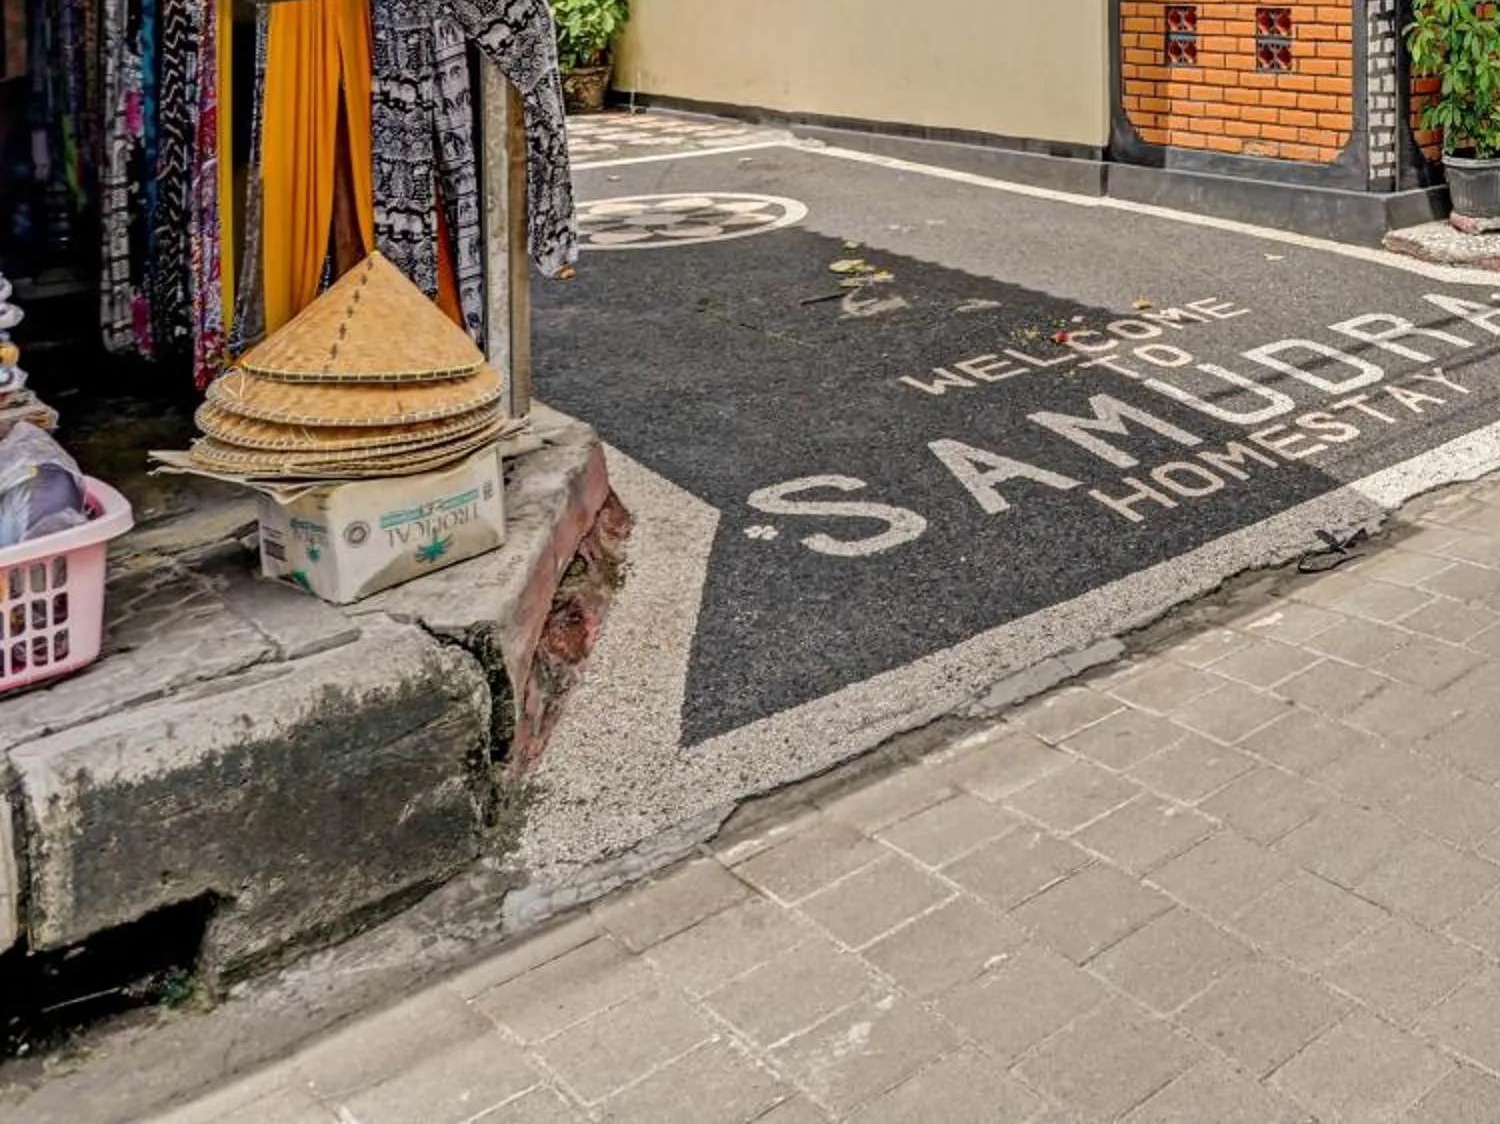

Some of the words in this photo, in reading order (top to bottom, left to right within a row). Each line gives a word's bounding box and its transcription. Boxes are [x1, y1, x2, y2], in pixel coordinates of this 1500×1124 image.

[899, 297, 1250, 397] WELCOME
[1080, 343, 1196, 378] TO
[1087, 367, 1472, 524] HOMESTAY
